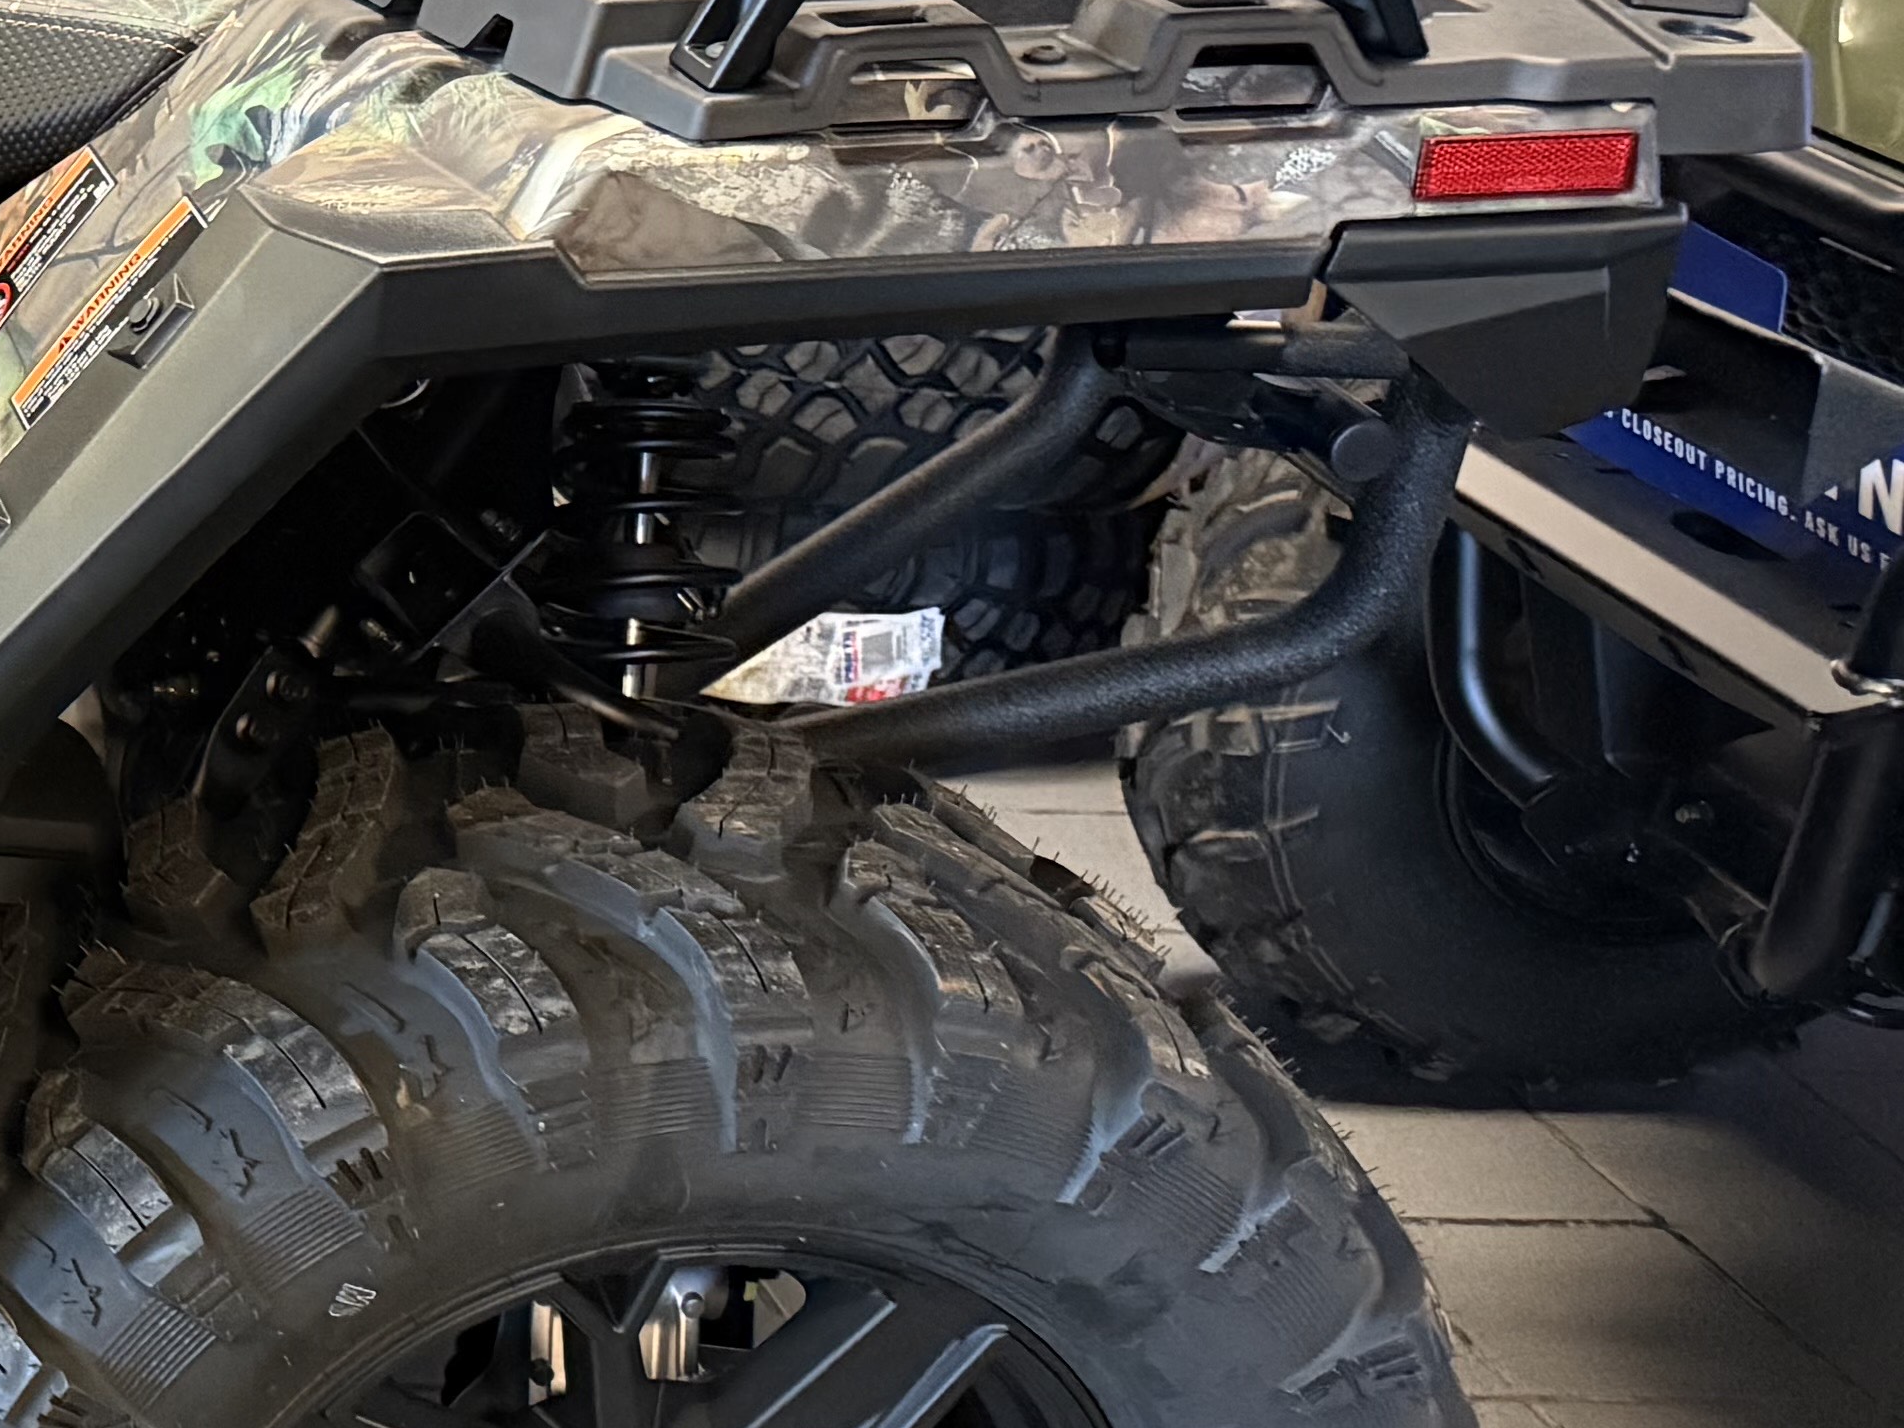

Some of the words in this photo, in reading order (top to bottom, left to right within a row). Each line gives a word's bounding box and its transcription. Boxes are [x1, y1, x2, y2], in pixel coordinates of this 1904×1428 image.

[72, 253, 142, 332] WARNING
[1621, 408, 1708, 471] CLOSEOUT
[1714, 459, 1798, 522] PRICING.
[1804, 510, 1840, 547] ASK
[1846, 534, 1873, 564] US
